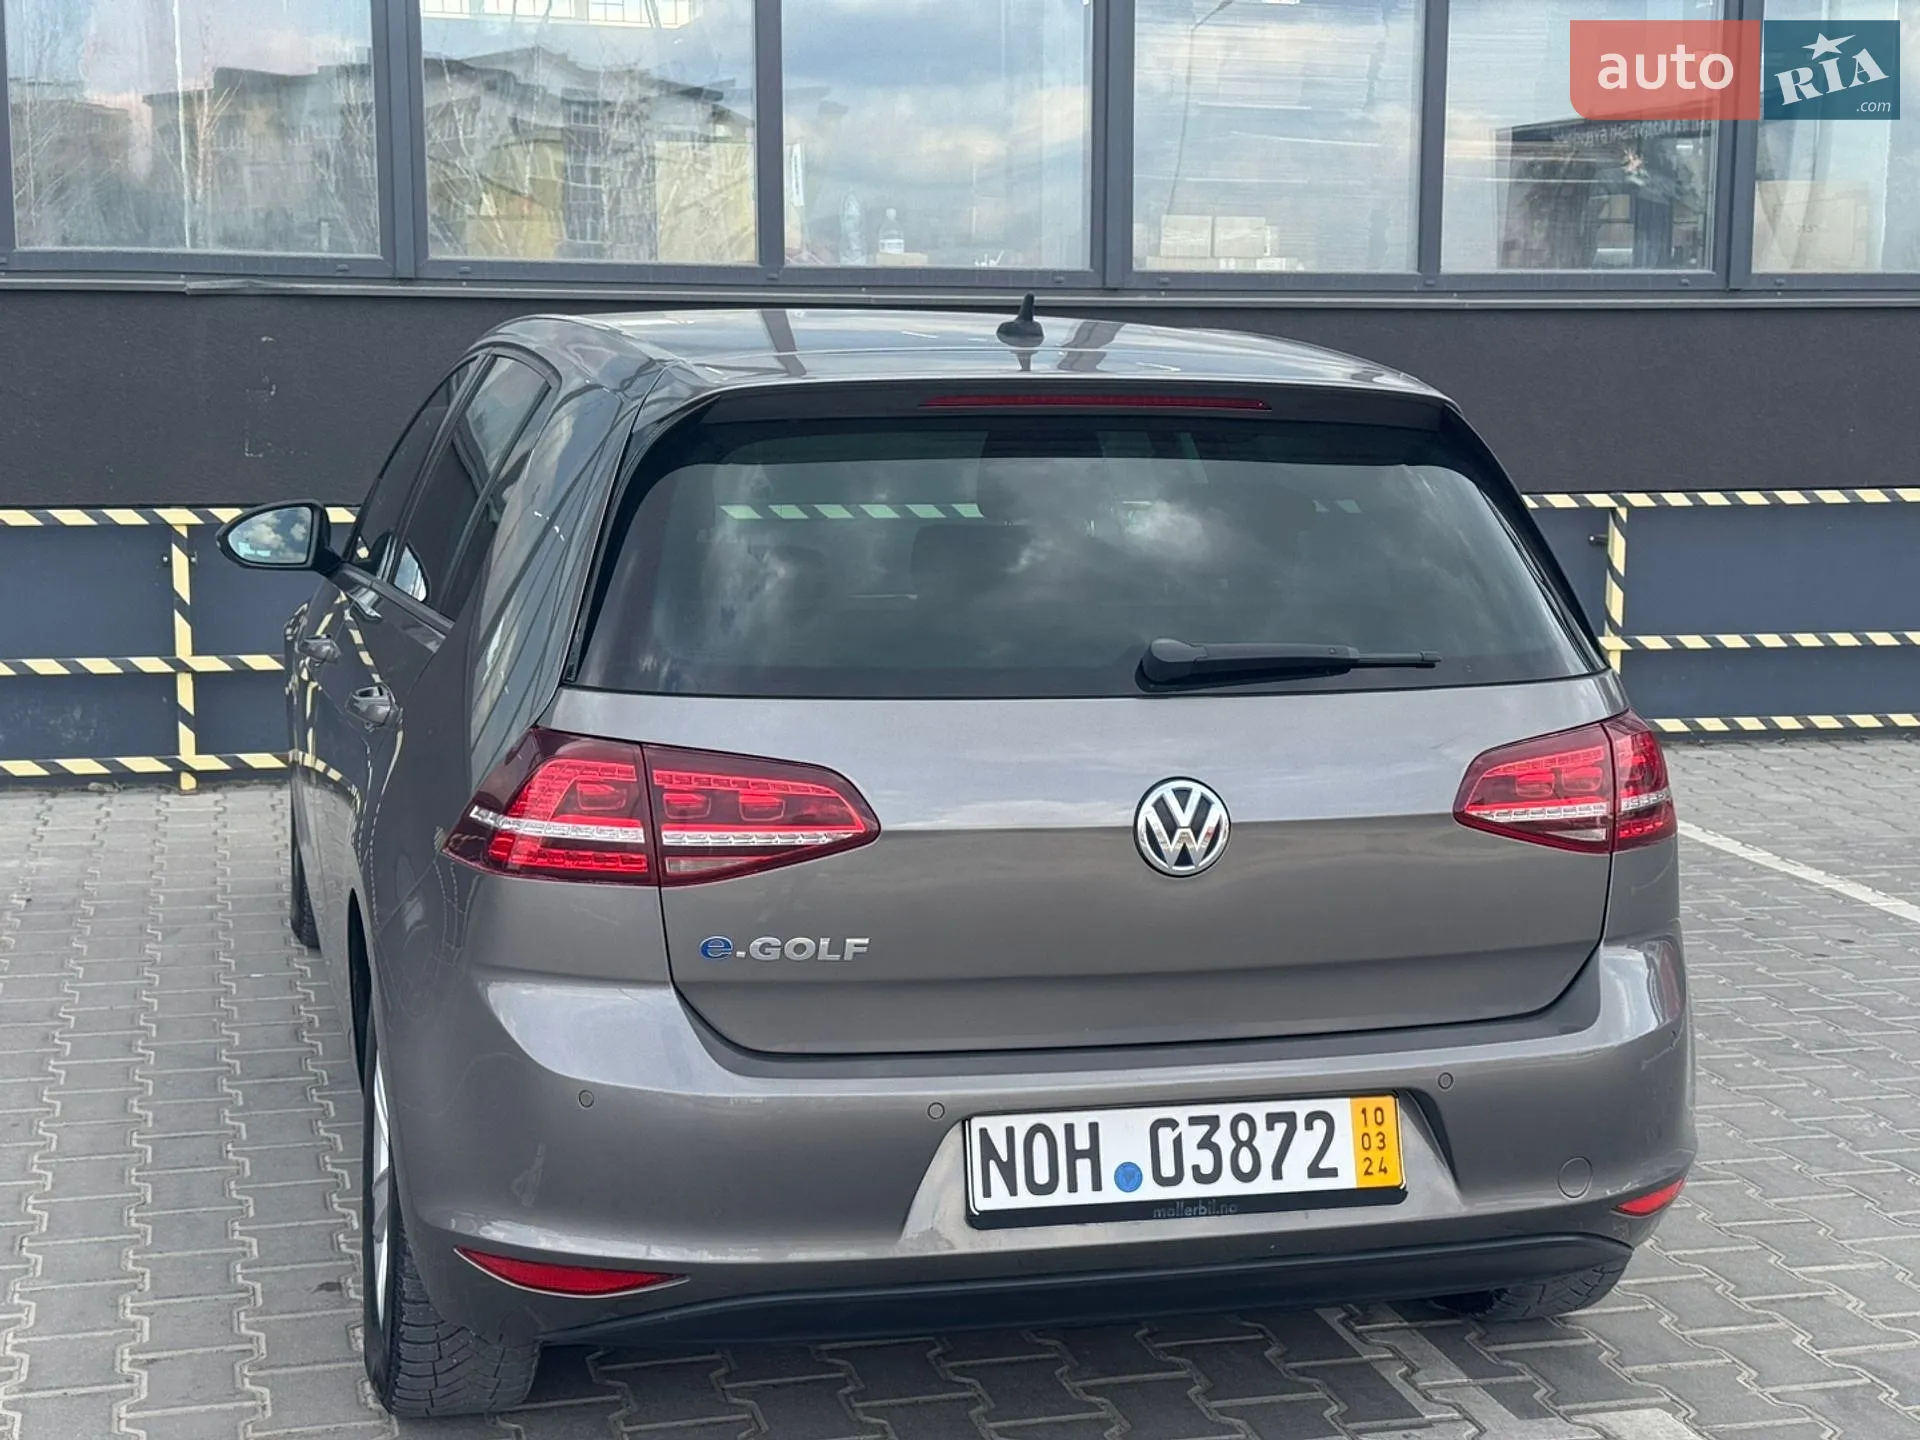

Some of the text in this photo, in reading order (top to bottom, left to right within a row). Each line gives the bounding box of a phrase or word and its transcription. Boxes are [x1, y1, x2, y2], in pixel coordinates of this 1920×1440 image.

[1140, 782, 1227, 871] VW
[1361, 1106, 1384, 1127] 10
[1361, 1131, 1386, 1151] 03
[979, 1110, 1338, 1199] NOH 03872
[1363, 1156, 1388, 1176] 24
